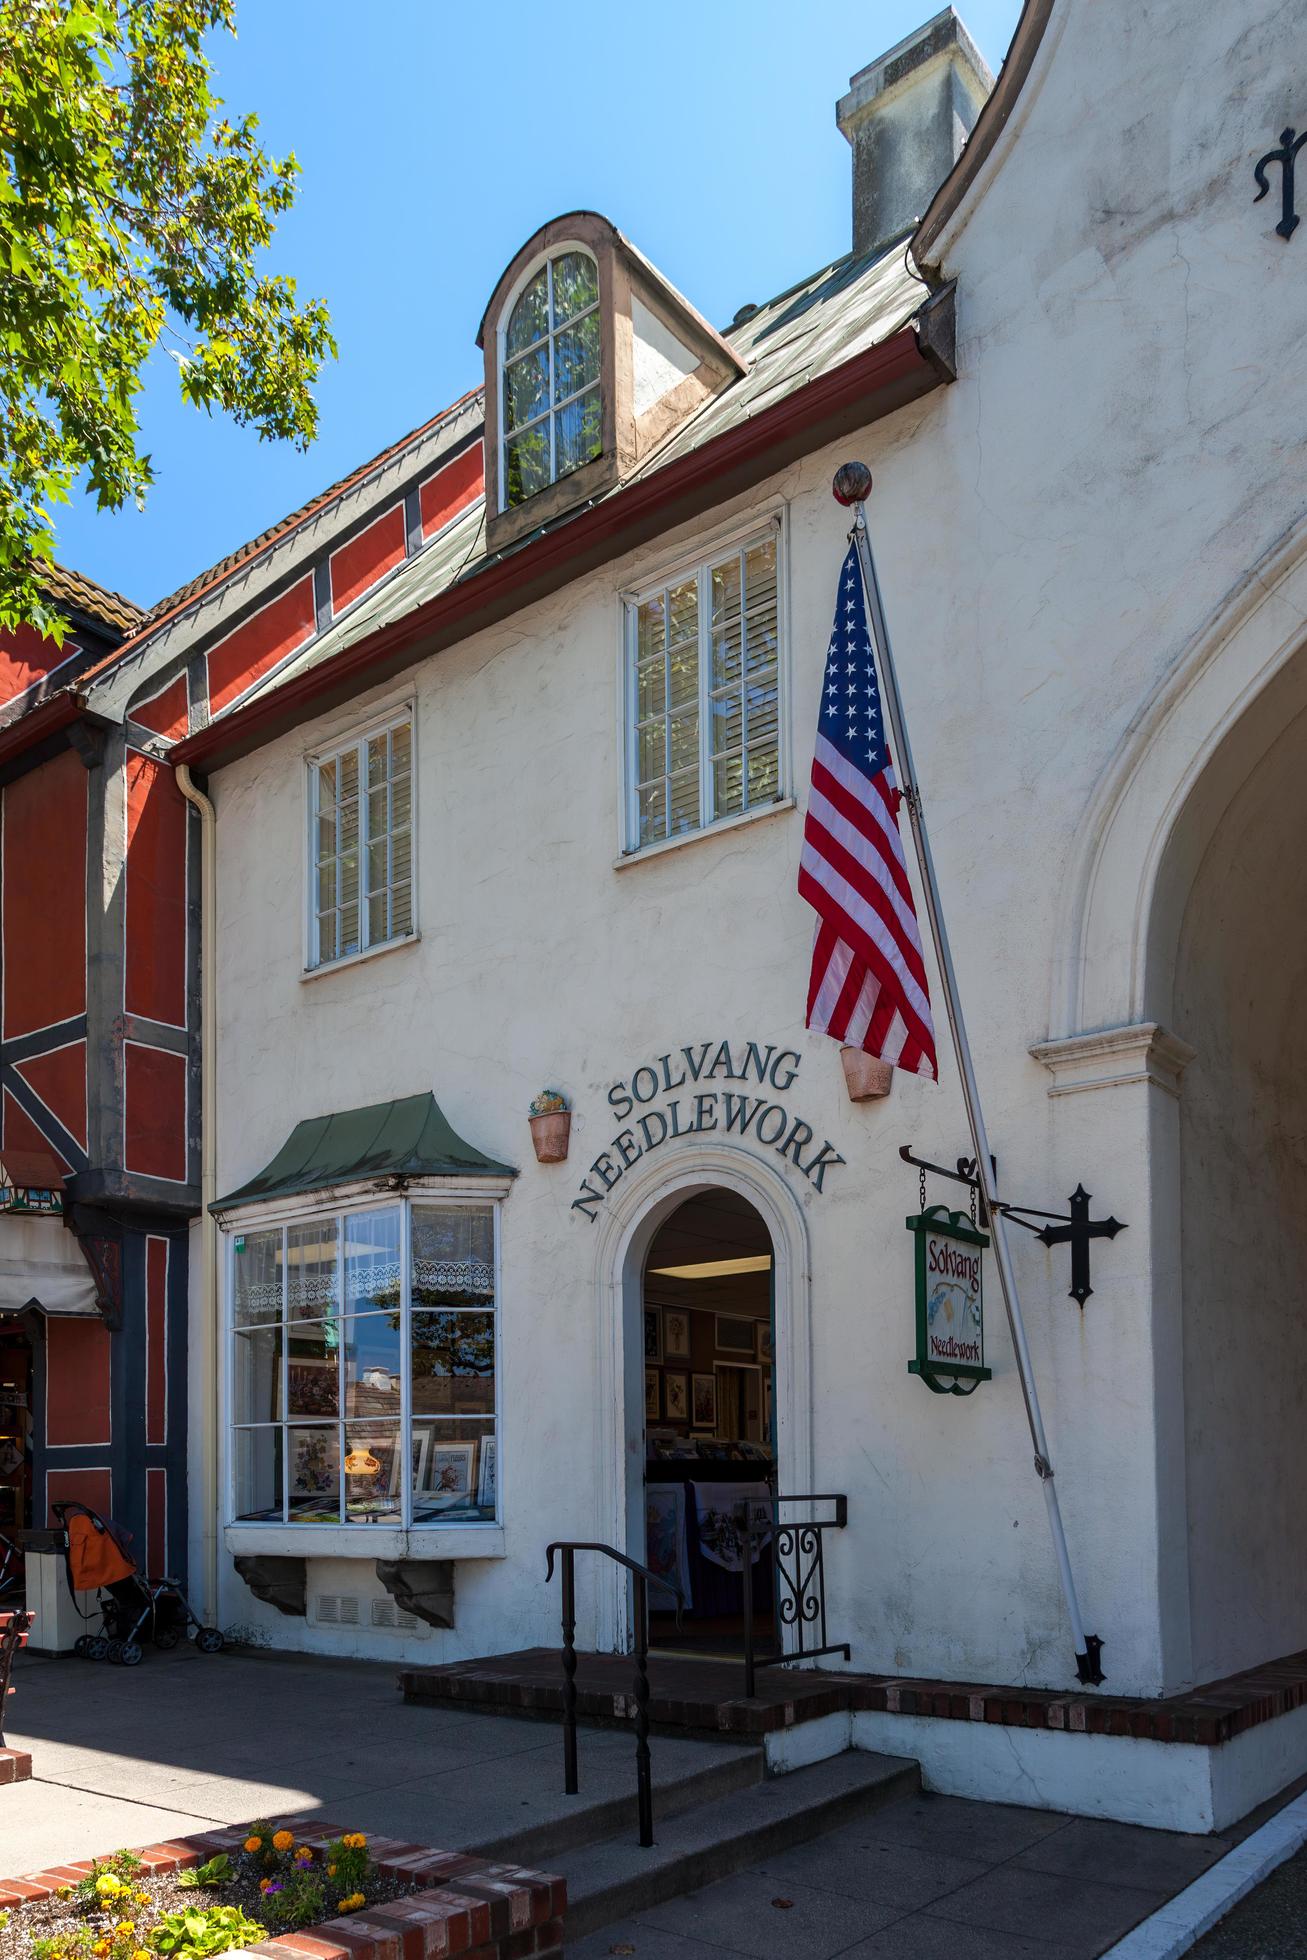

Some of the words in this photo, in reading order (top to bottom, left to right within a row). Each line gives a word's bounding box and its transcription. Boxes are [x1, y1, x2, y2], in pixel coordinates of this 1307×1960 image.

[607, 1040, 802, 1122] SOLVANG
[570, 1092, 847, 1224] NEEDLEWORK
[928, 1239, 980, 1293] Solvang
[930, 1335, 980, 1361] Needlework
